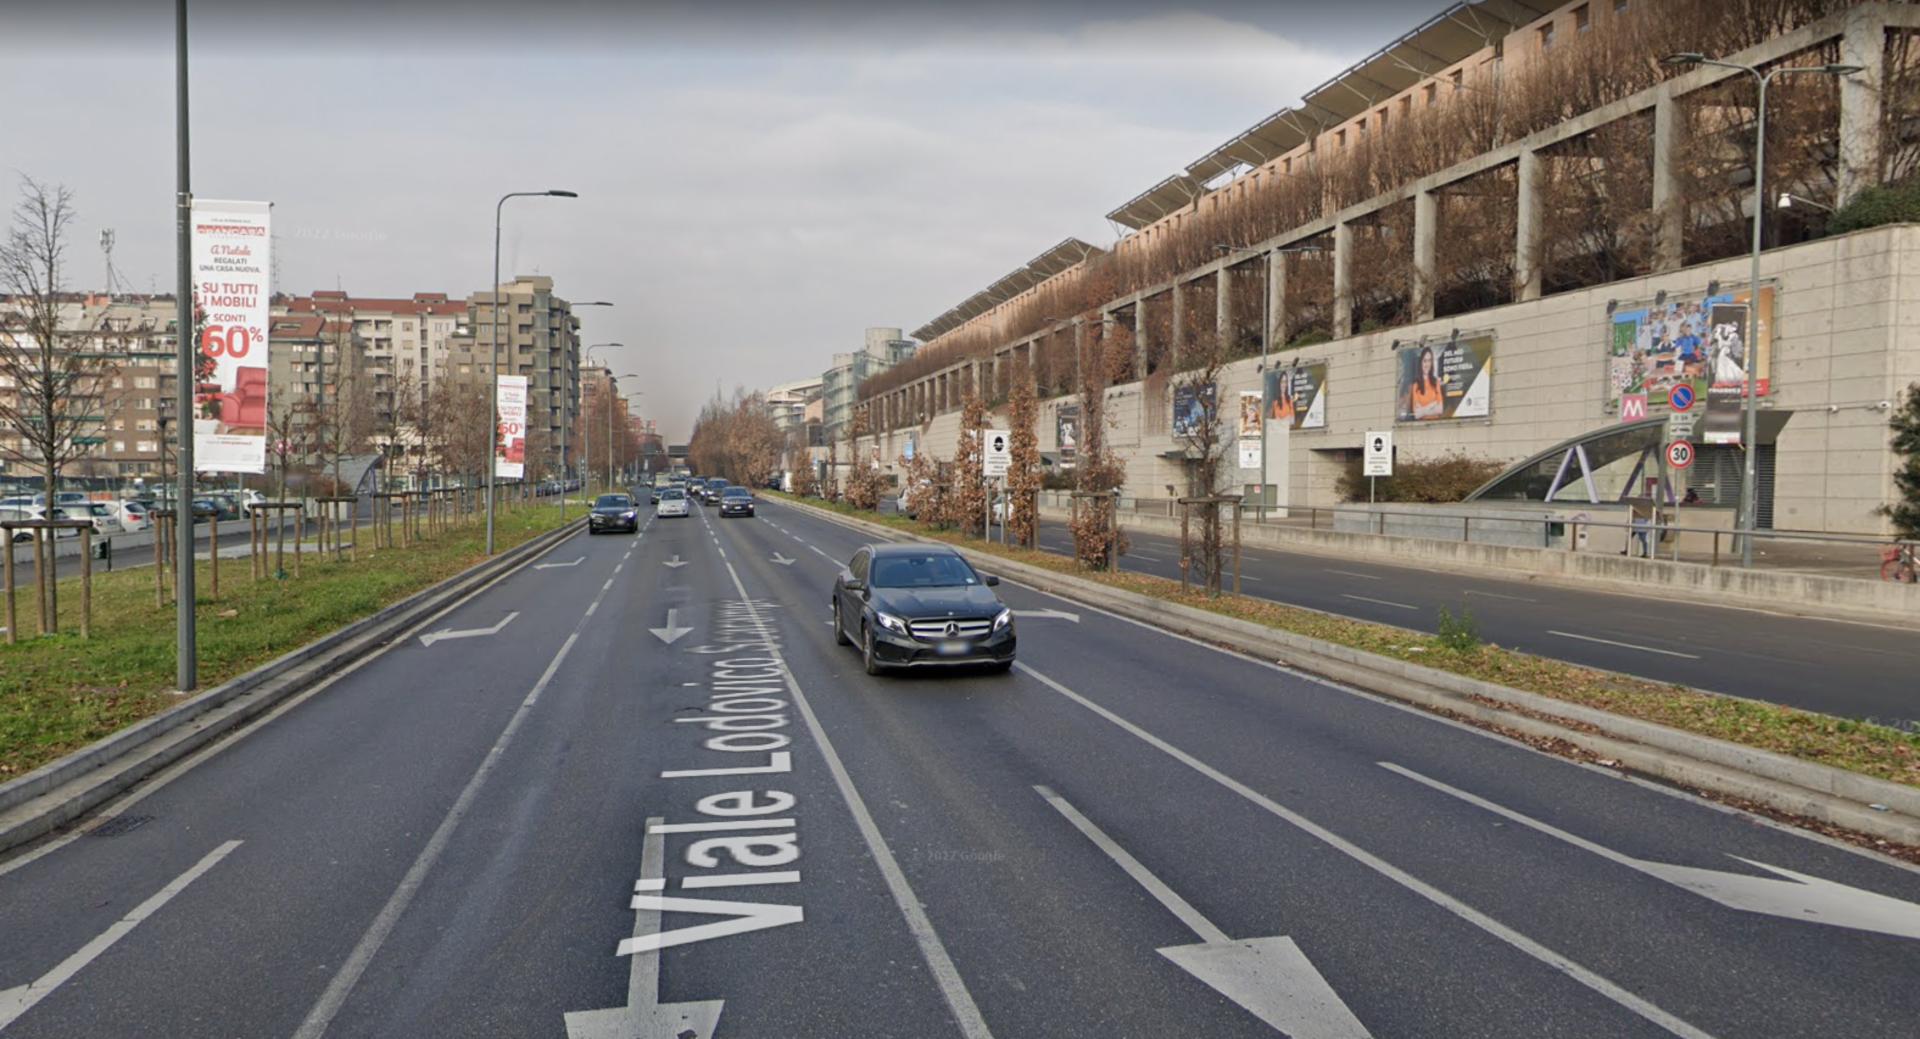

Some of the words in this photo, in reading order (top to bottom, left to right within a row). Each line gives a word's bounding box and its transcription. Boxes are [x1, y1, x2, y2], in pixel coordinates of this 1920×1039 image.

[202, 282, 218, 293] SU
[222, 283, 258, 295] TUTTI
[203, 296, 207, 306] I
[210, 296, 257, 308] MOBILI
[213, 313, 246, 322] SCONTI
[202, 324, 264, 358] 60%
[1623, 400, 1644, 417] M
[1672, 447, 1689, 461] 30
